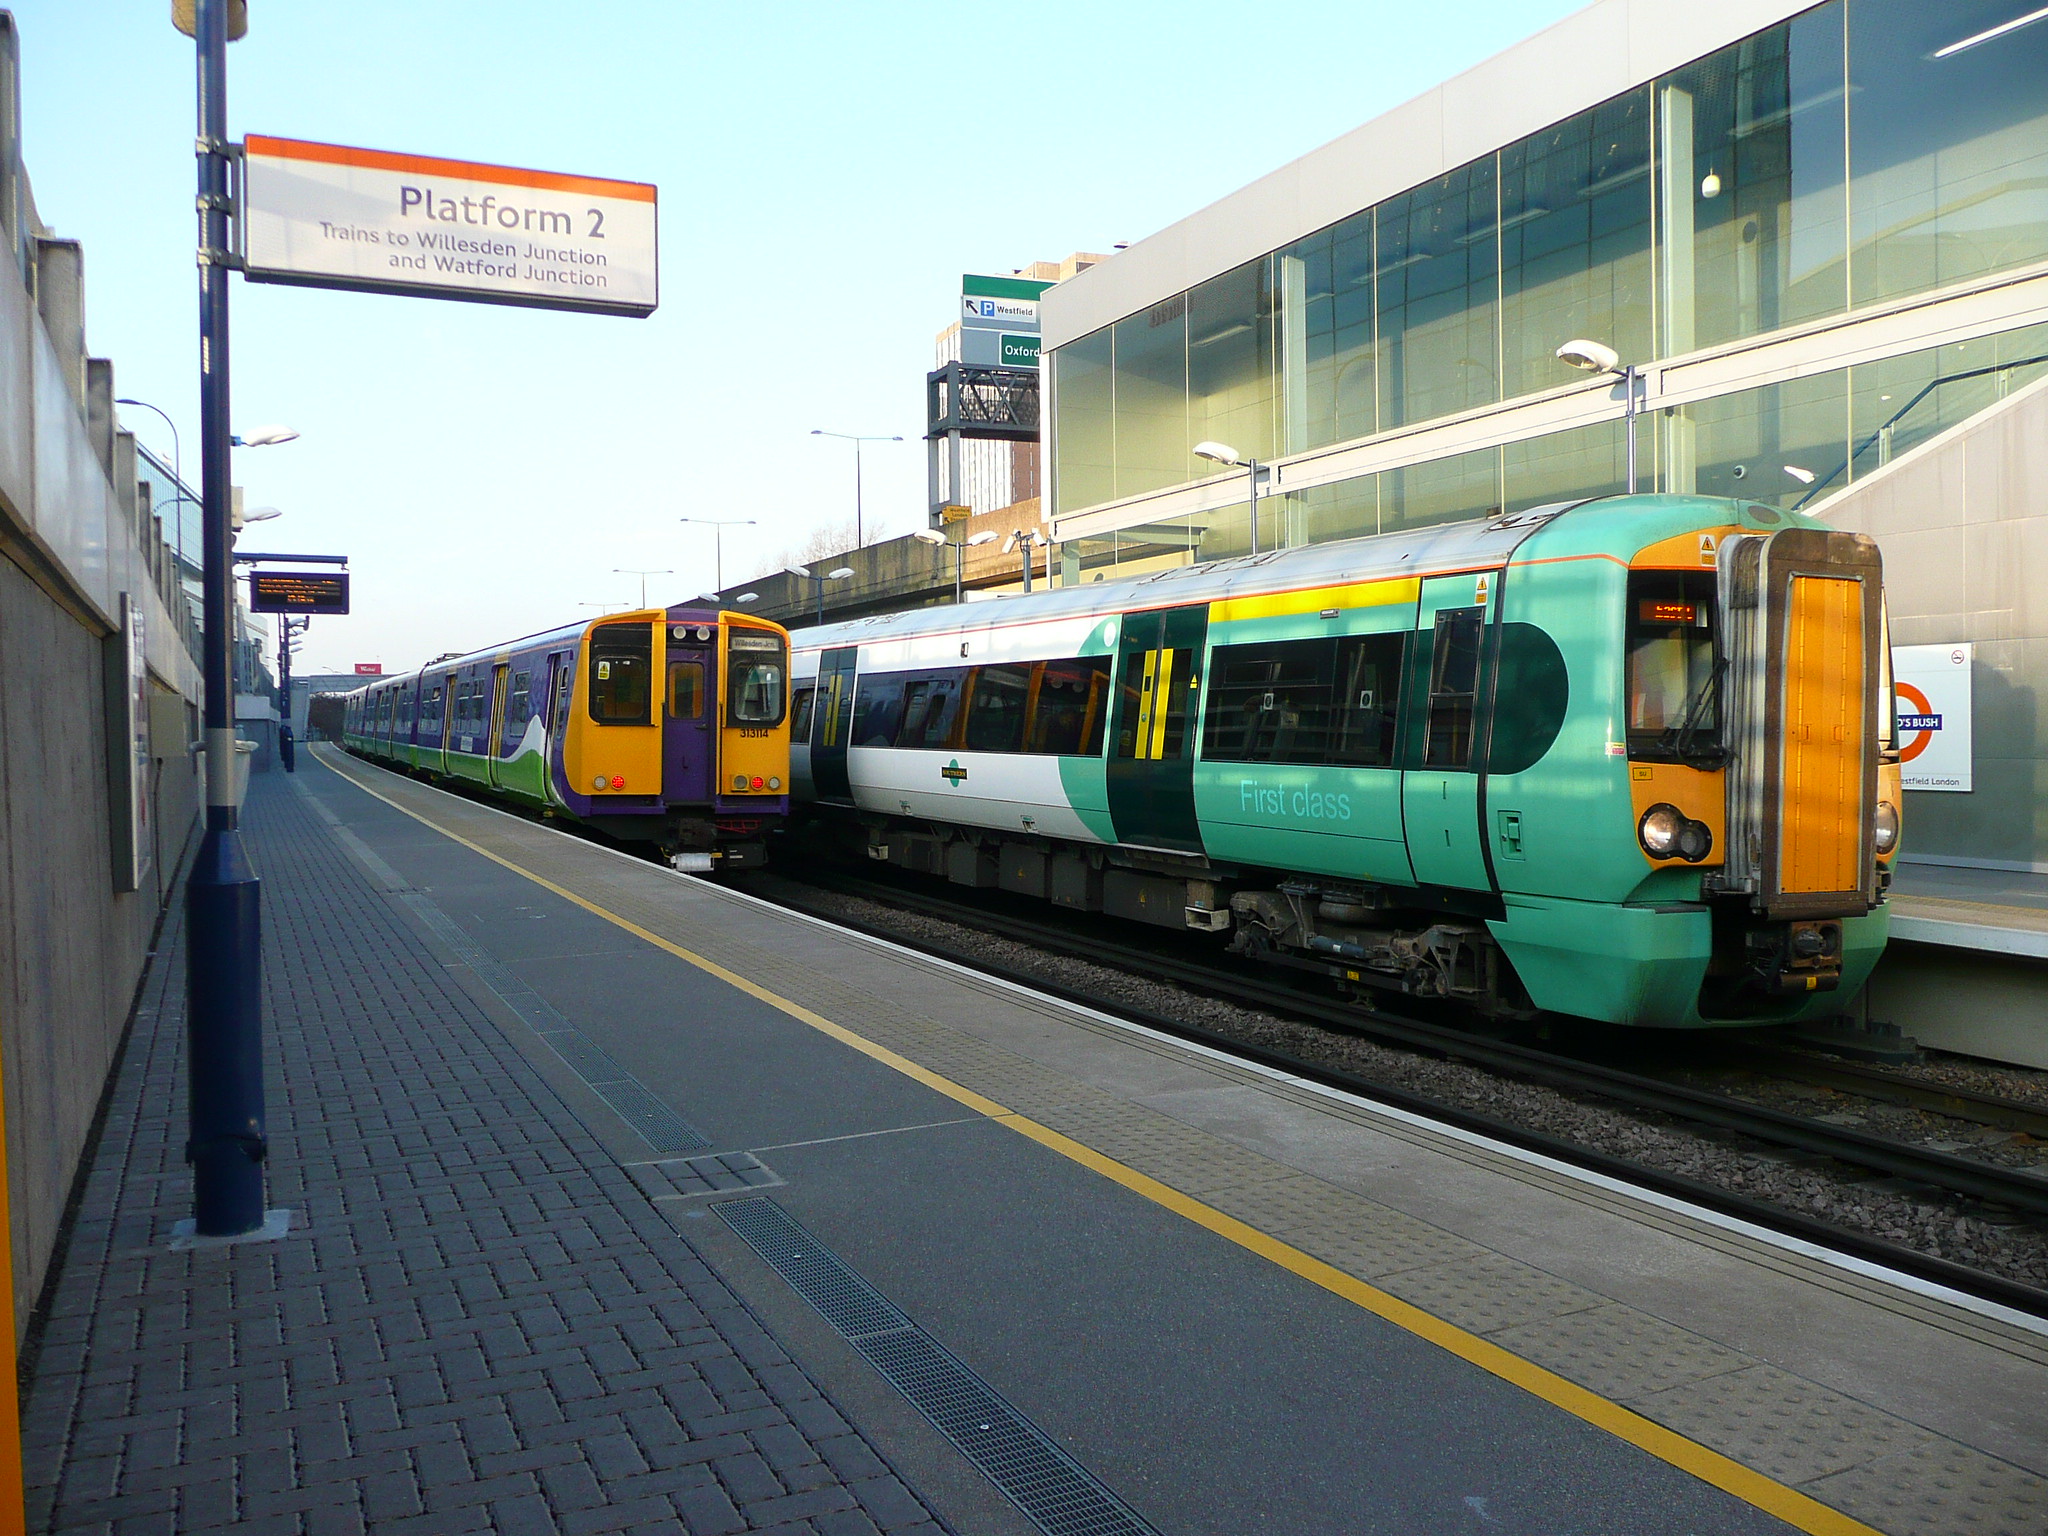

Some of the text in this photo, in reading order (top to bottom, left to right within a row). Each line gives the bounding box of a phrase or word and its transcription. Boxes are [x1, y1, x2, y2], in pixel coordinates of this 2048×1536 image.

[400, 185, 605, 239] Platform 2
[319, 221, 607, 266] Trains to Willesden Junction
[389, 254, 607, 288] and Watford Junction
[997, 305, 1033, 316] Westfield
[1005, 345, 1040, 357] Oxford
[1913, 718, 1938, 728] BUSH
[740, 728, 769, 738] 313114
[1932, 778, 1959, 786] London
[1241, 780, 1350, 820] First class
